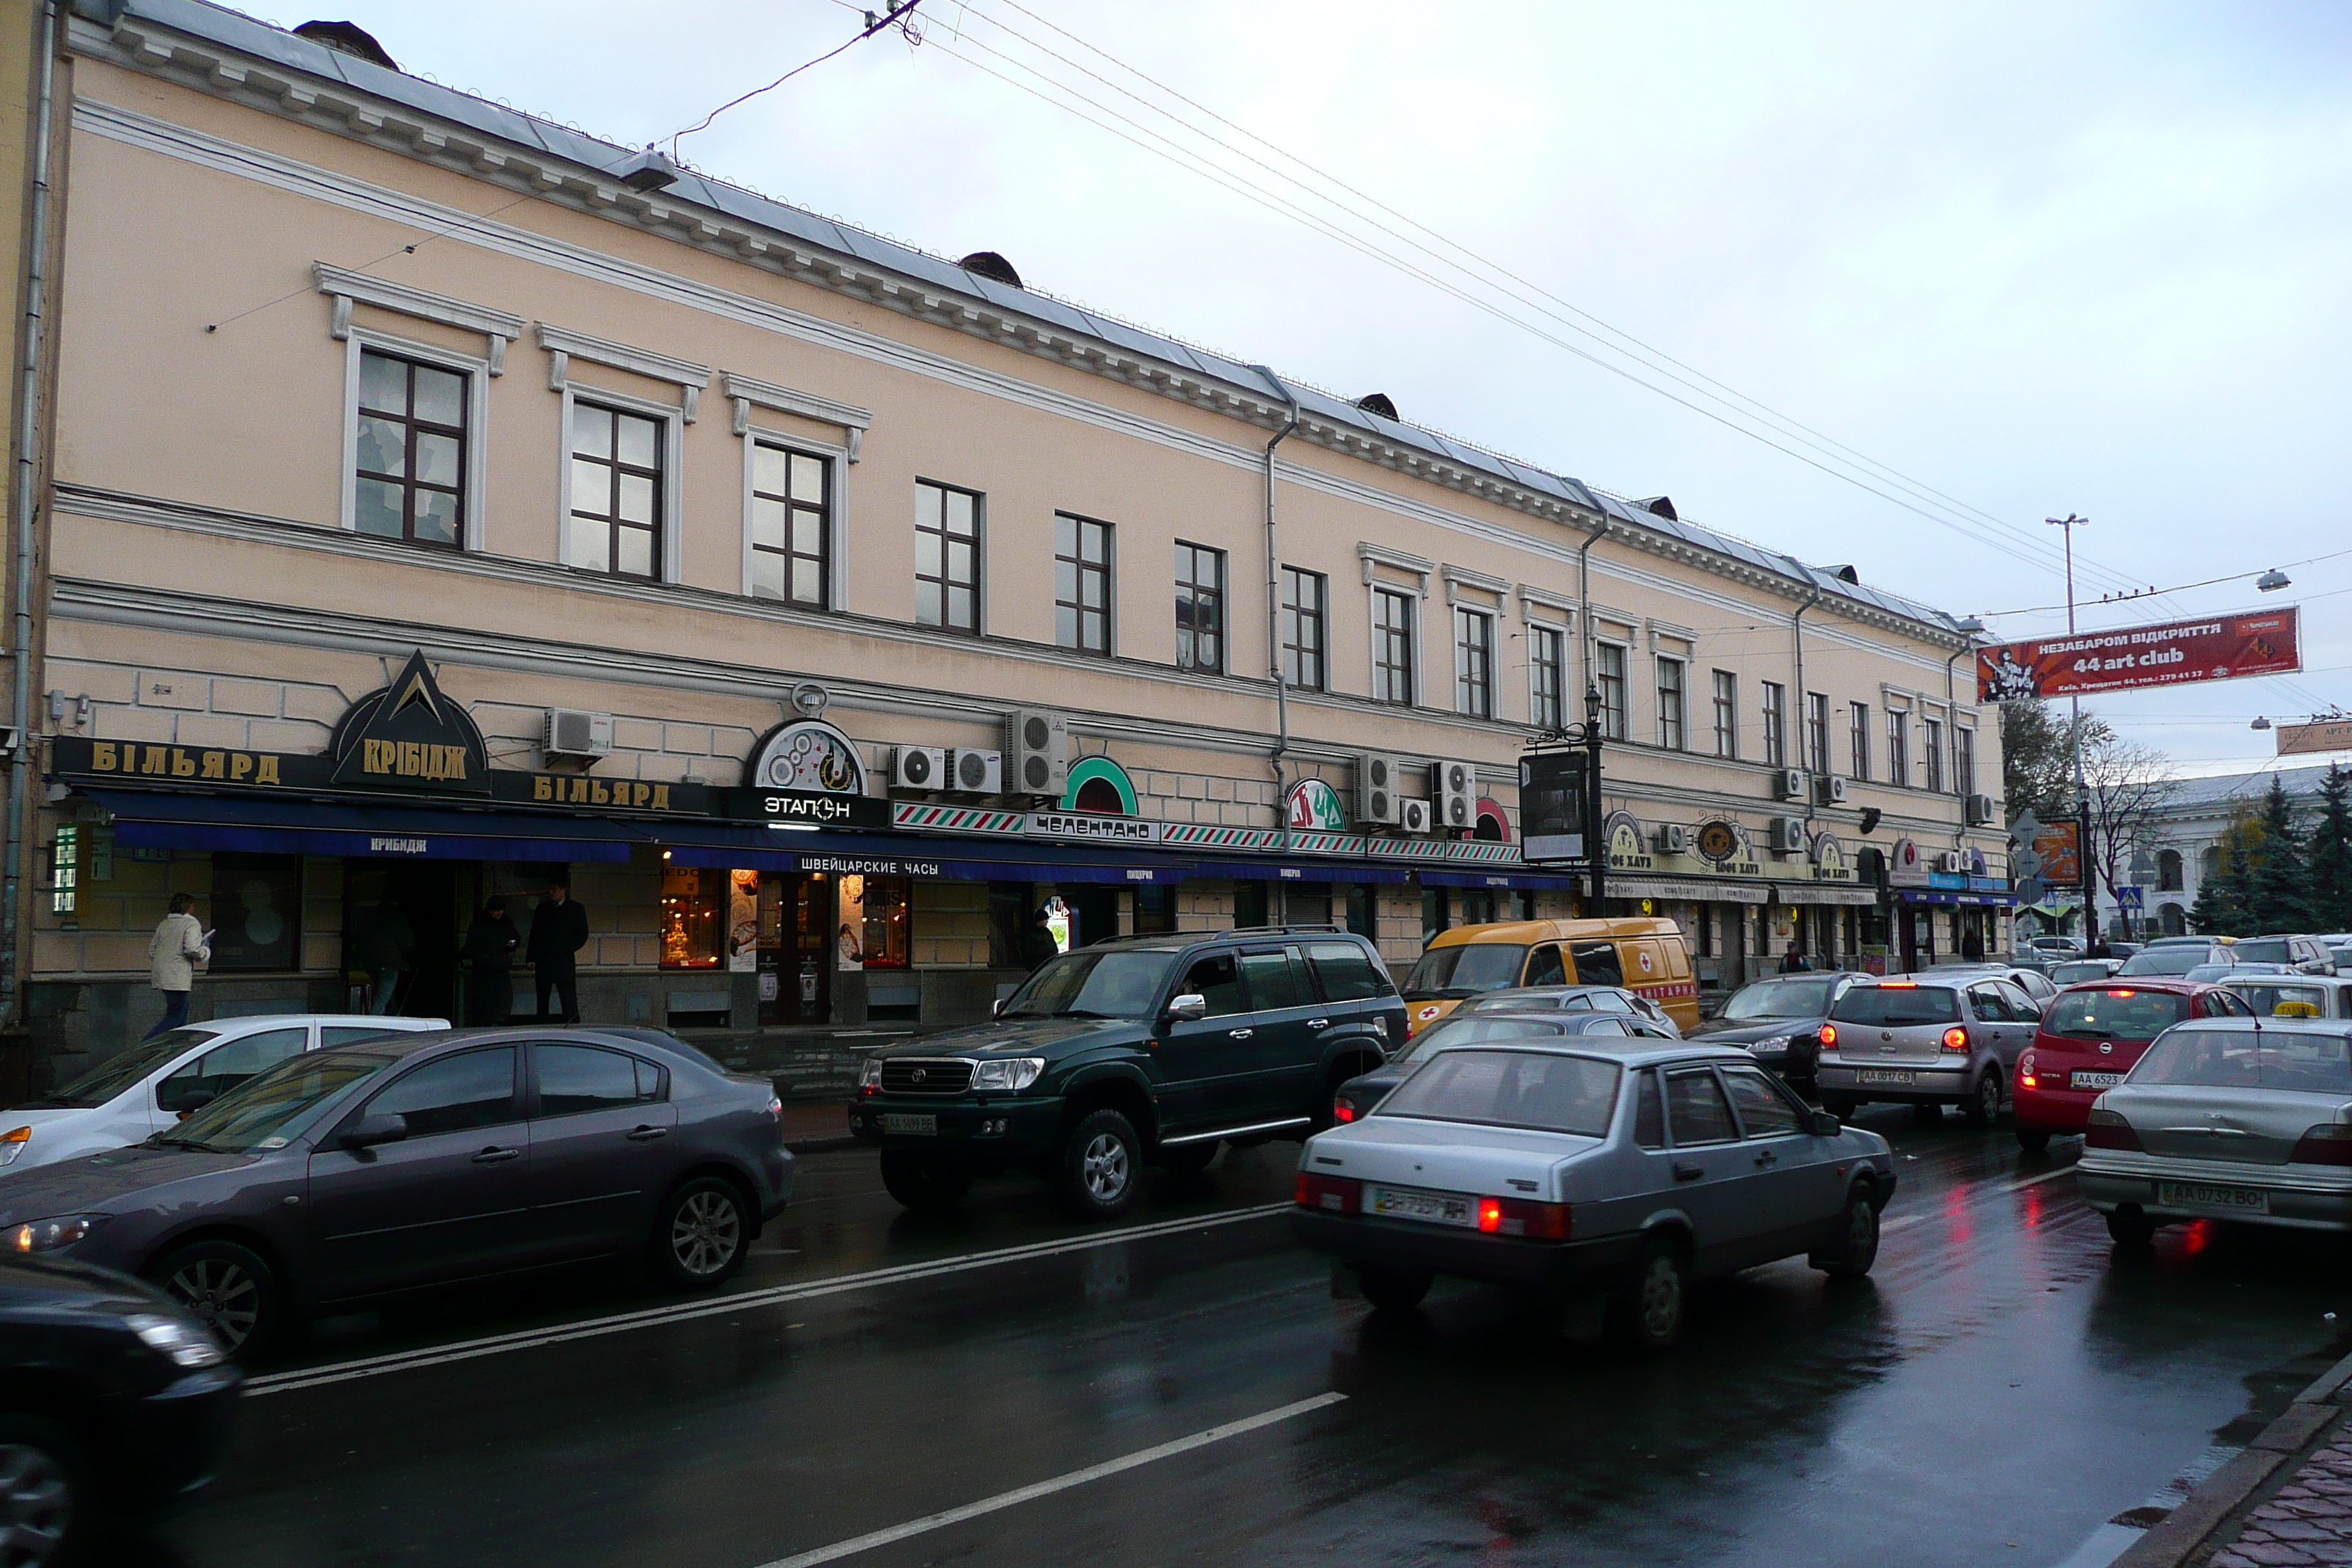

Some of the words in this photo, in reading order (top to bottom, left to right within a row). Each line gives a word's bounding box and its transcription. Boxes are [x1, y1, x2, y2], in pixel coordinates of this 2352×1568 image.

[2039, 635, 2128, 655] НЕЗАБАРОМ
[2131, 623, 2222, 646] ВІДКРИТТЯ
[2073, 657, 2101, 673] 44
[2104, 655, 2135, 670] art
[2139, 647, 2184, 666] club
[2160, 673, 2176, 681] 279
[92, 742, 280, 784] БІЛЬЯРД
[363, 739, 467, 781] КРІБІДЖ
[533, 776, 669, 810] БІЛЬЯРД
[764, 796, 850, 821] ЭТАЛОН
[1037, 816, 1149, 839] ЧЕЛЕНТАНО
[371, 837, 427, 853] КРИБИДЖ
[802, 857, 897, 873] ШВЕЙЦАРСКИЕ
[905, 863, 938, 875] ЧАСЫ
[1612, 854, 1624, 866] ФЕ
[1627, 855, 1651, 868] ХАУЗ
[862, 890, 901, 905] OIS
[1865, 1071, 1876, 1080] AA
[1877, 1072, 1896, 1080] 0017
[1898, 1072, 1910, 1081] CB
[2078, 1074, 2092, 1084] AA
[2094, 1074, 2118, 1085] 6523
[2174, 1186, 2194, 1201] AA
[2198, 1188, 2231, 1204] 0732
[2235, 1191, 2258, 1205] BO
